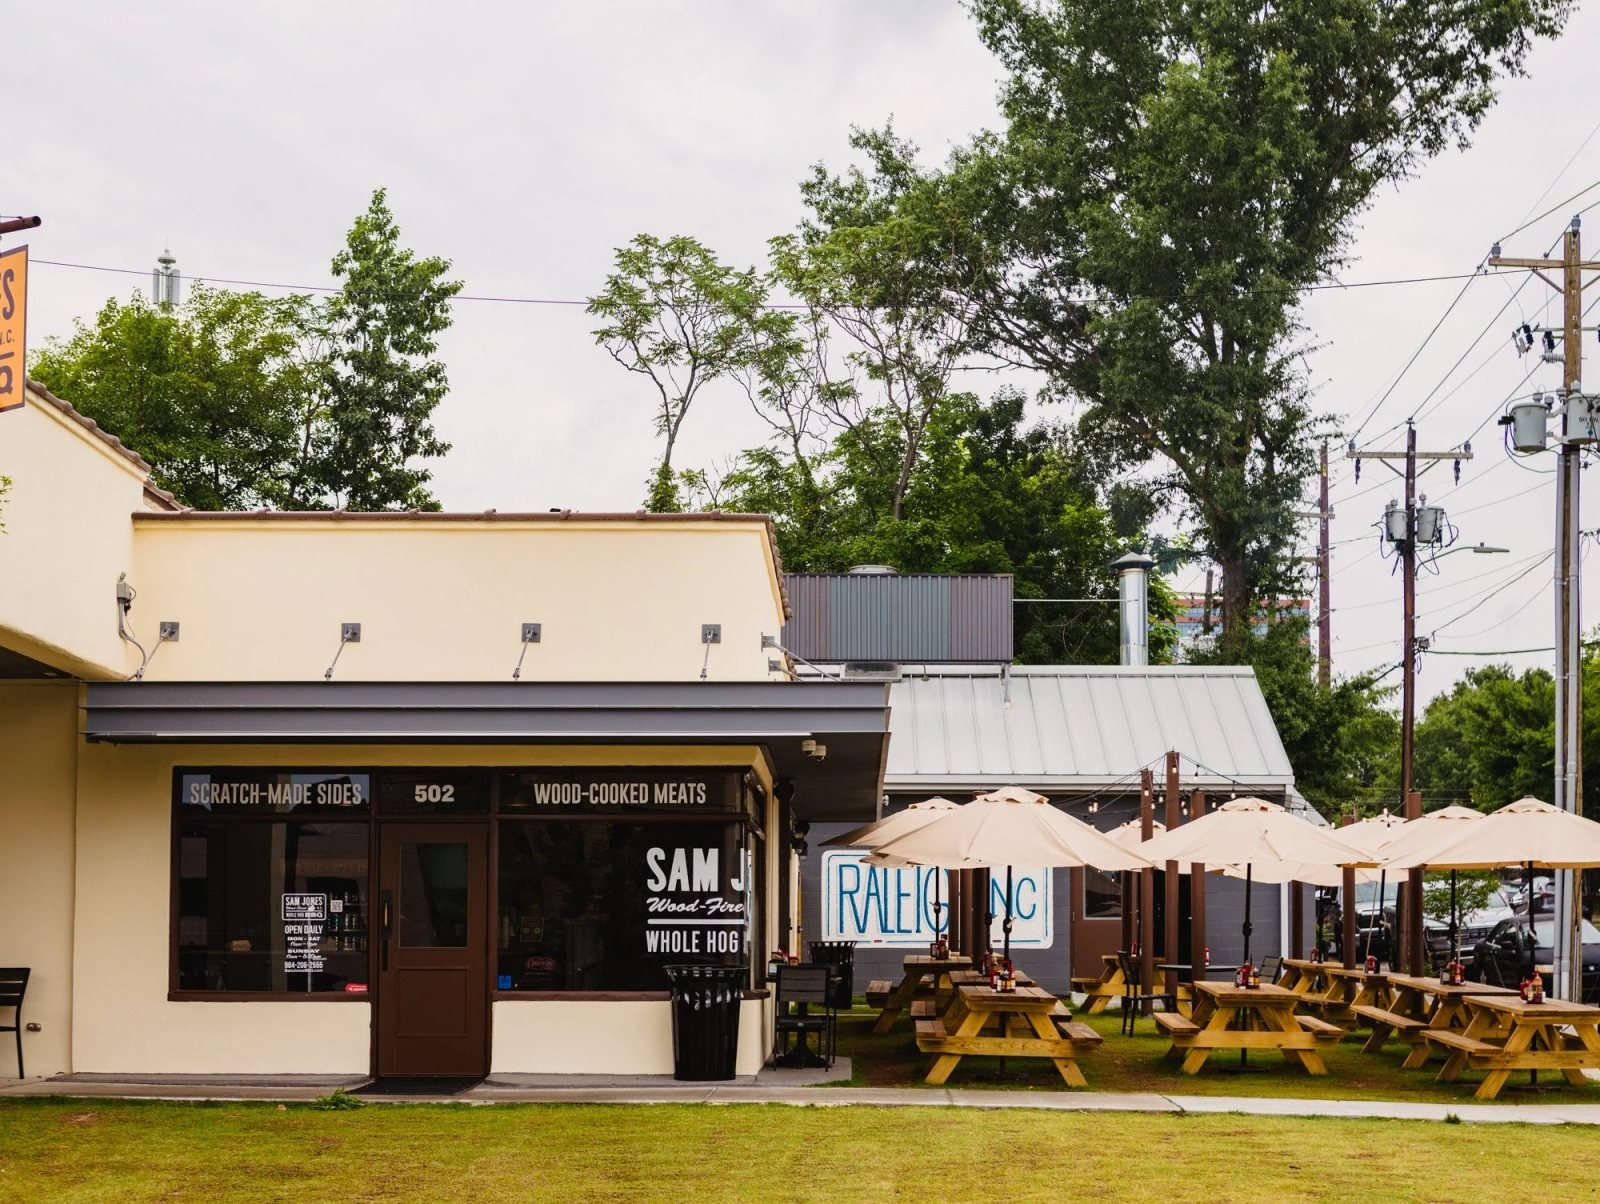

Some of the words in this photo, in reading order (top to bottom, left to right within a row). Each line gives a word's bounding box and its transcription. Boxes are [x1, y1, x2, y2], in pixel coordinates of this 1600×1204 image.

[0, 269, 15, 320] S
[190, 783, 311, 805] SCRATCH-MADE
[317, 783, 362, 805] SIDES
[414, 784, 455, 803] 502
[534, 783, 649, 805] WOOD-COOKED
[654, 783, 706, 804] MEATS
[646, 847, 719, 892] SAM
[285, 896, 300, 906] SAM
[301, 896, 323, 906] JONES
[646, 897, 745, 915] Wood-Fire
[838, 864, 949, 934] RALEIG
[284, 925, 302, 934] OPEN
[304, 925, 323, 934] DAILY
[646, 930, 700, 953] WHOLE
[707, 930, 739, 953] HOG
